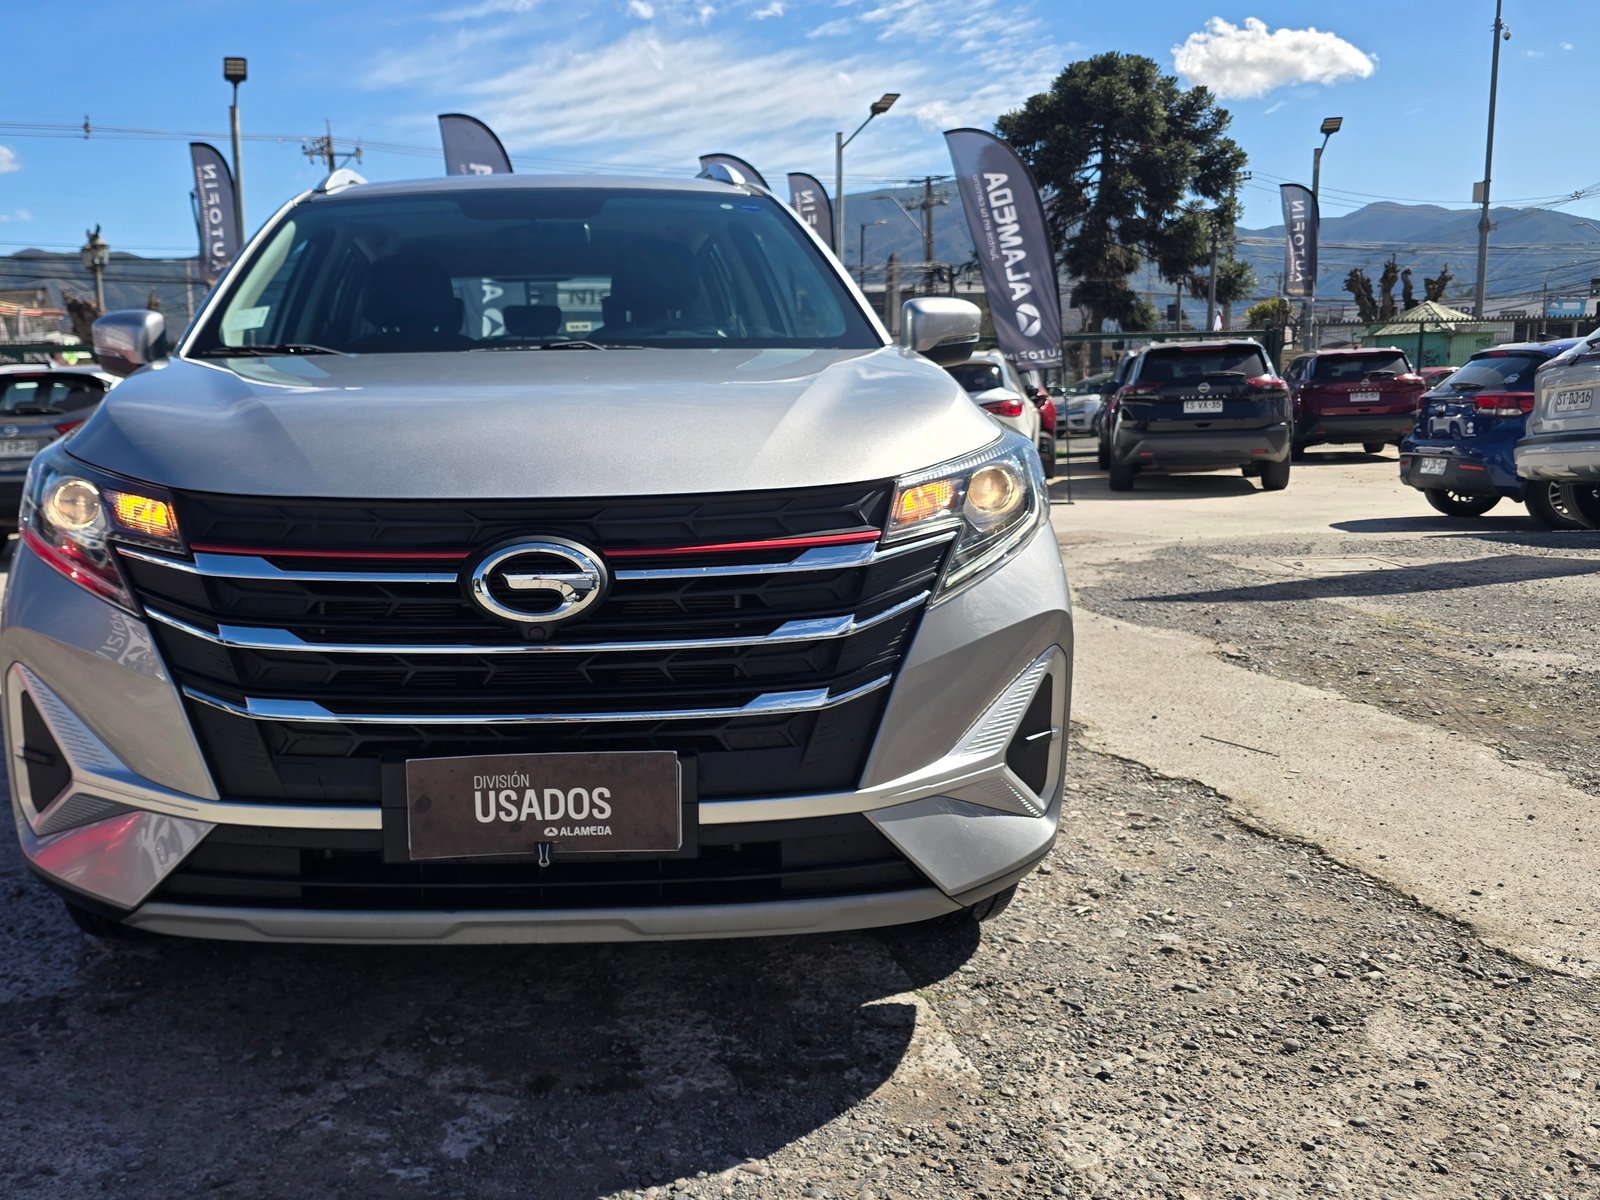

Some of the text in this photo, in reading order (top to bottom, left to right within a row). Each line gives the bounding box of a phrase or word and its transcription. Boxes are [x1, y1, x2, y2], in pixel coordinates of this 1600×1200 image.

[473, 771, 530, 790] DIVISIÓN
[474, 787, 612, 824] USADOS
[559, 825, 612, 837] ALAMEDA
